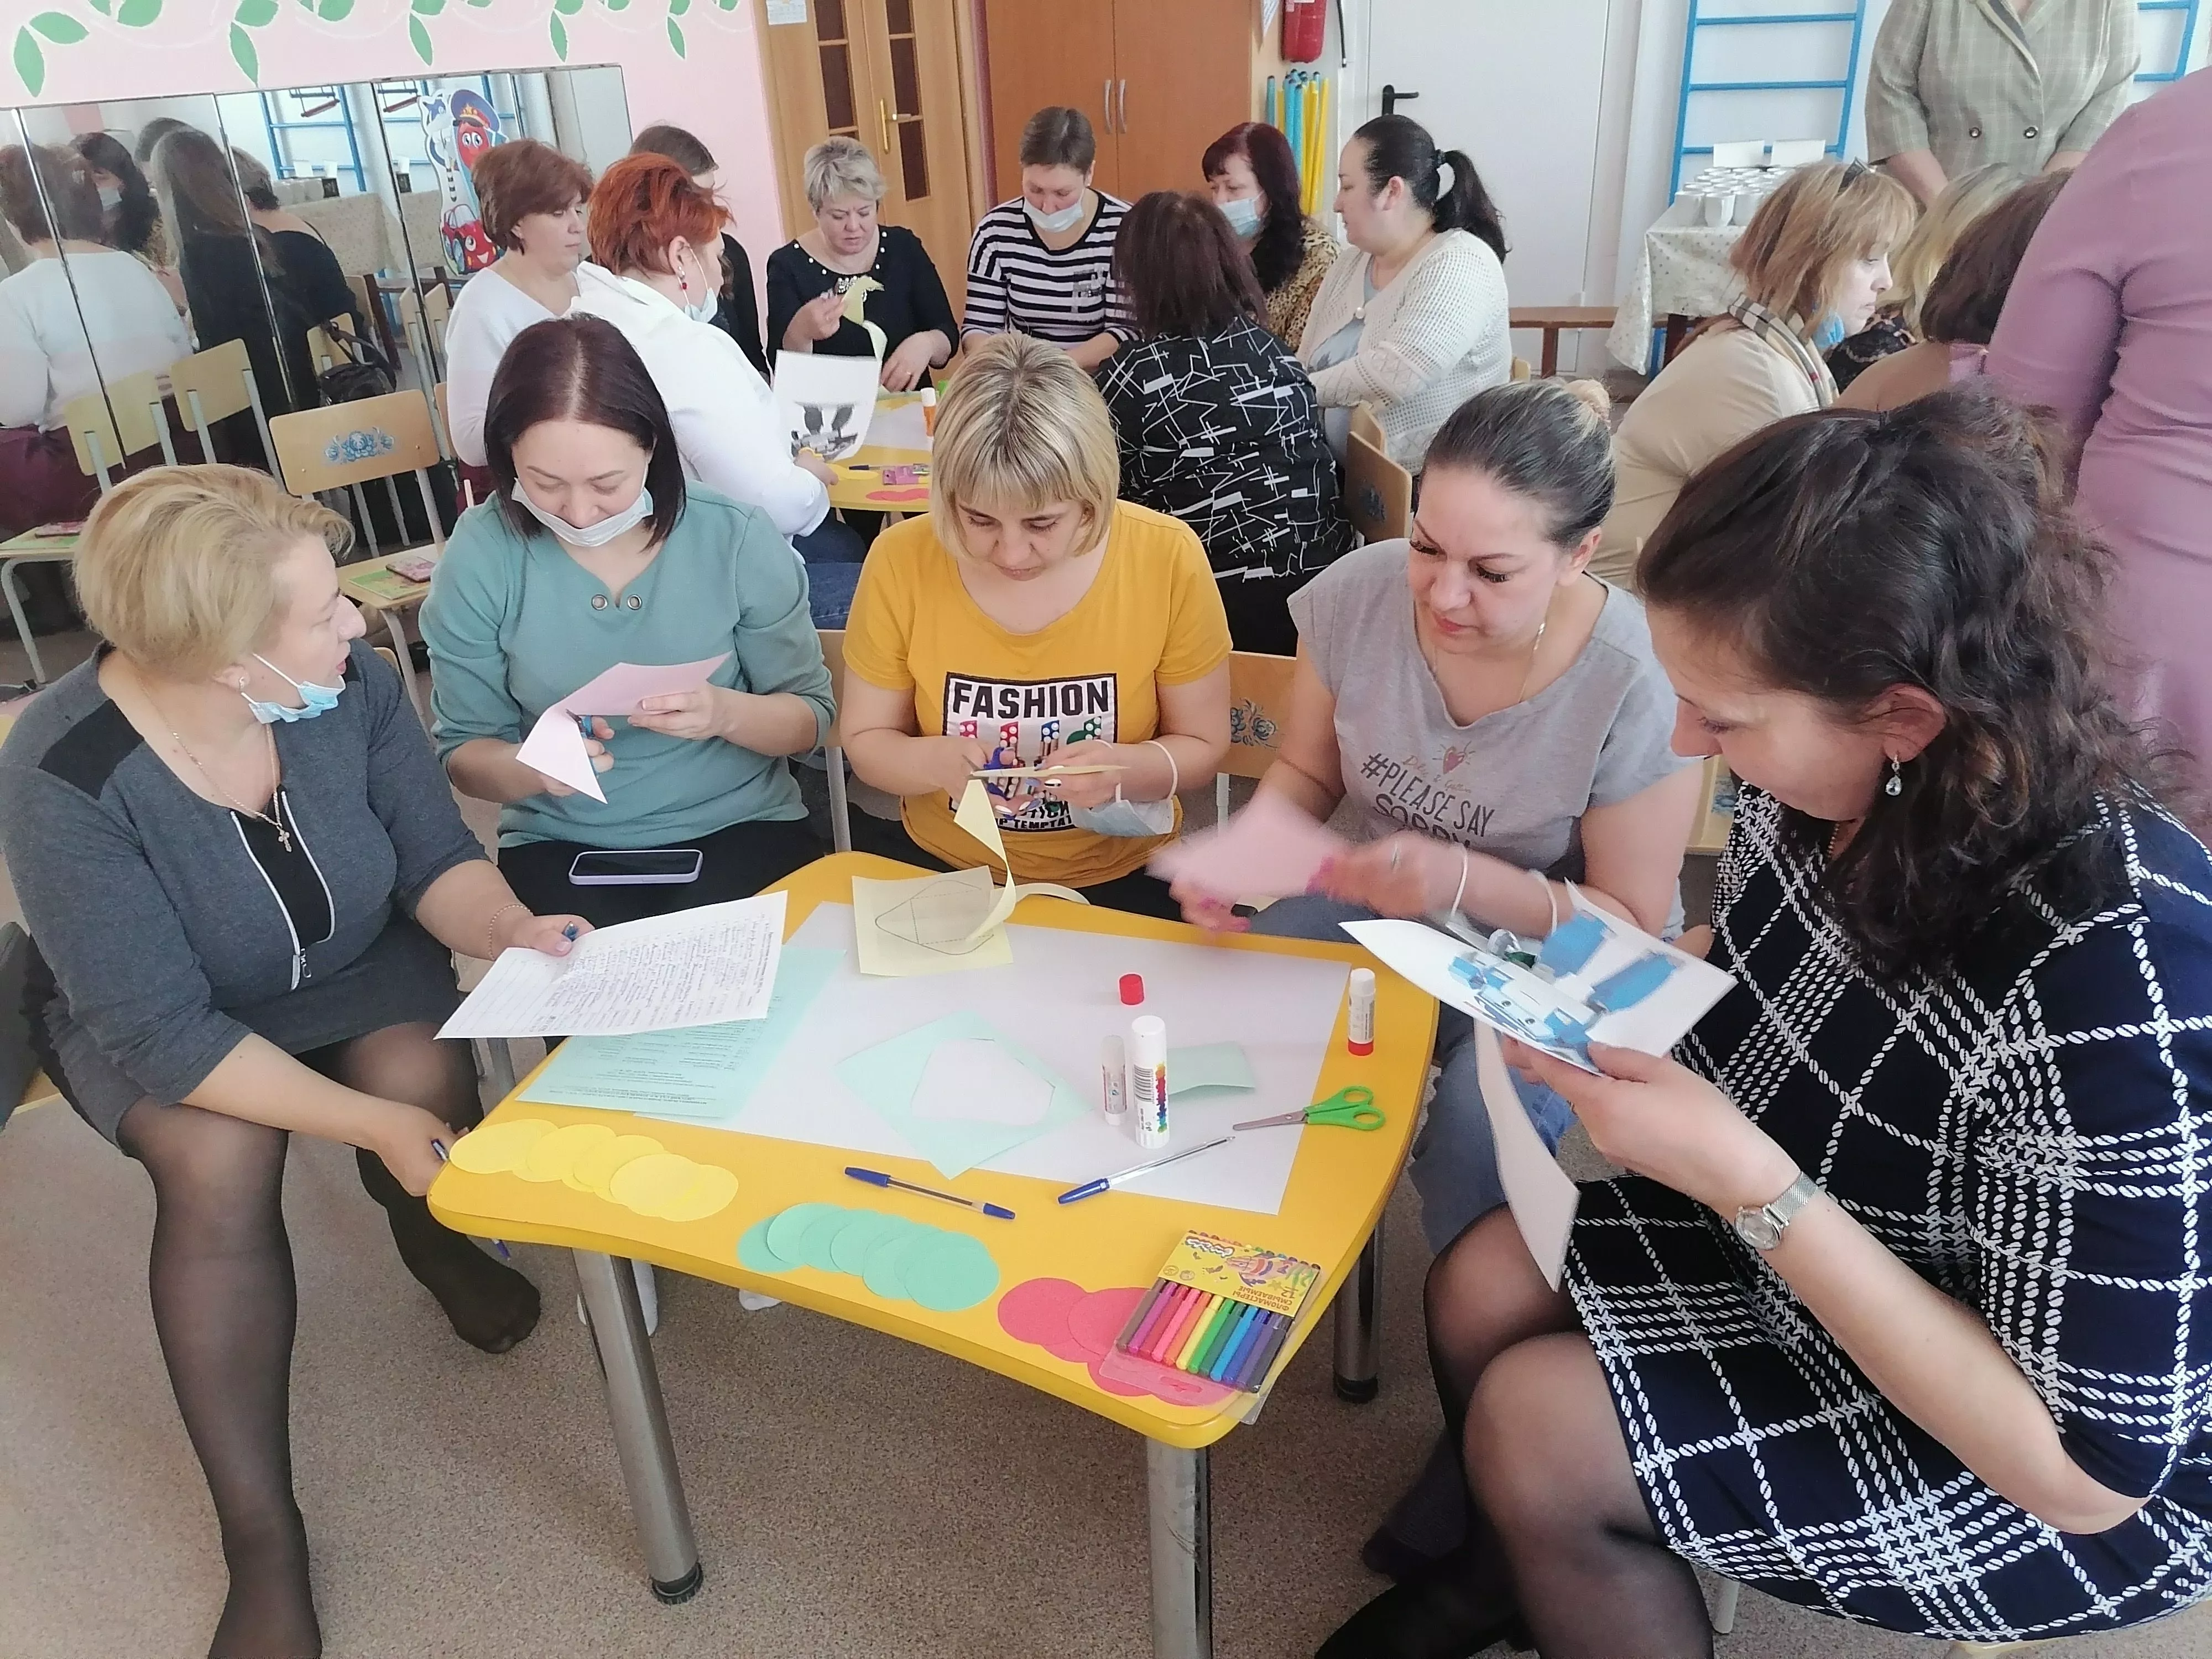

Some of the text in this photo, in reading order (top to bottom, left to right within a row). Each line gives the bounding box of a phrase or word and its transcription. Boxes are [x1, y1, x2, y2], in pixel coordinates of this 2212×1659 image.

[952, 681, 1109, 718] FASHION
[1360, 753, 1455, 822] #PLEASE
[1453, 800, 1495, 837] SAY
[1232, 1290, 1290, 1311] ФЛОМАСТЕРЫ
[1238, 1286, 1292, 1305] СМЫВАЕМЫЕ
[1281, 1288, 1295, 1298] 12
